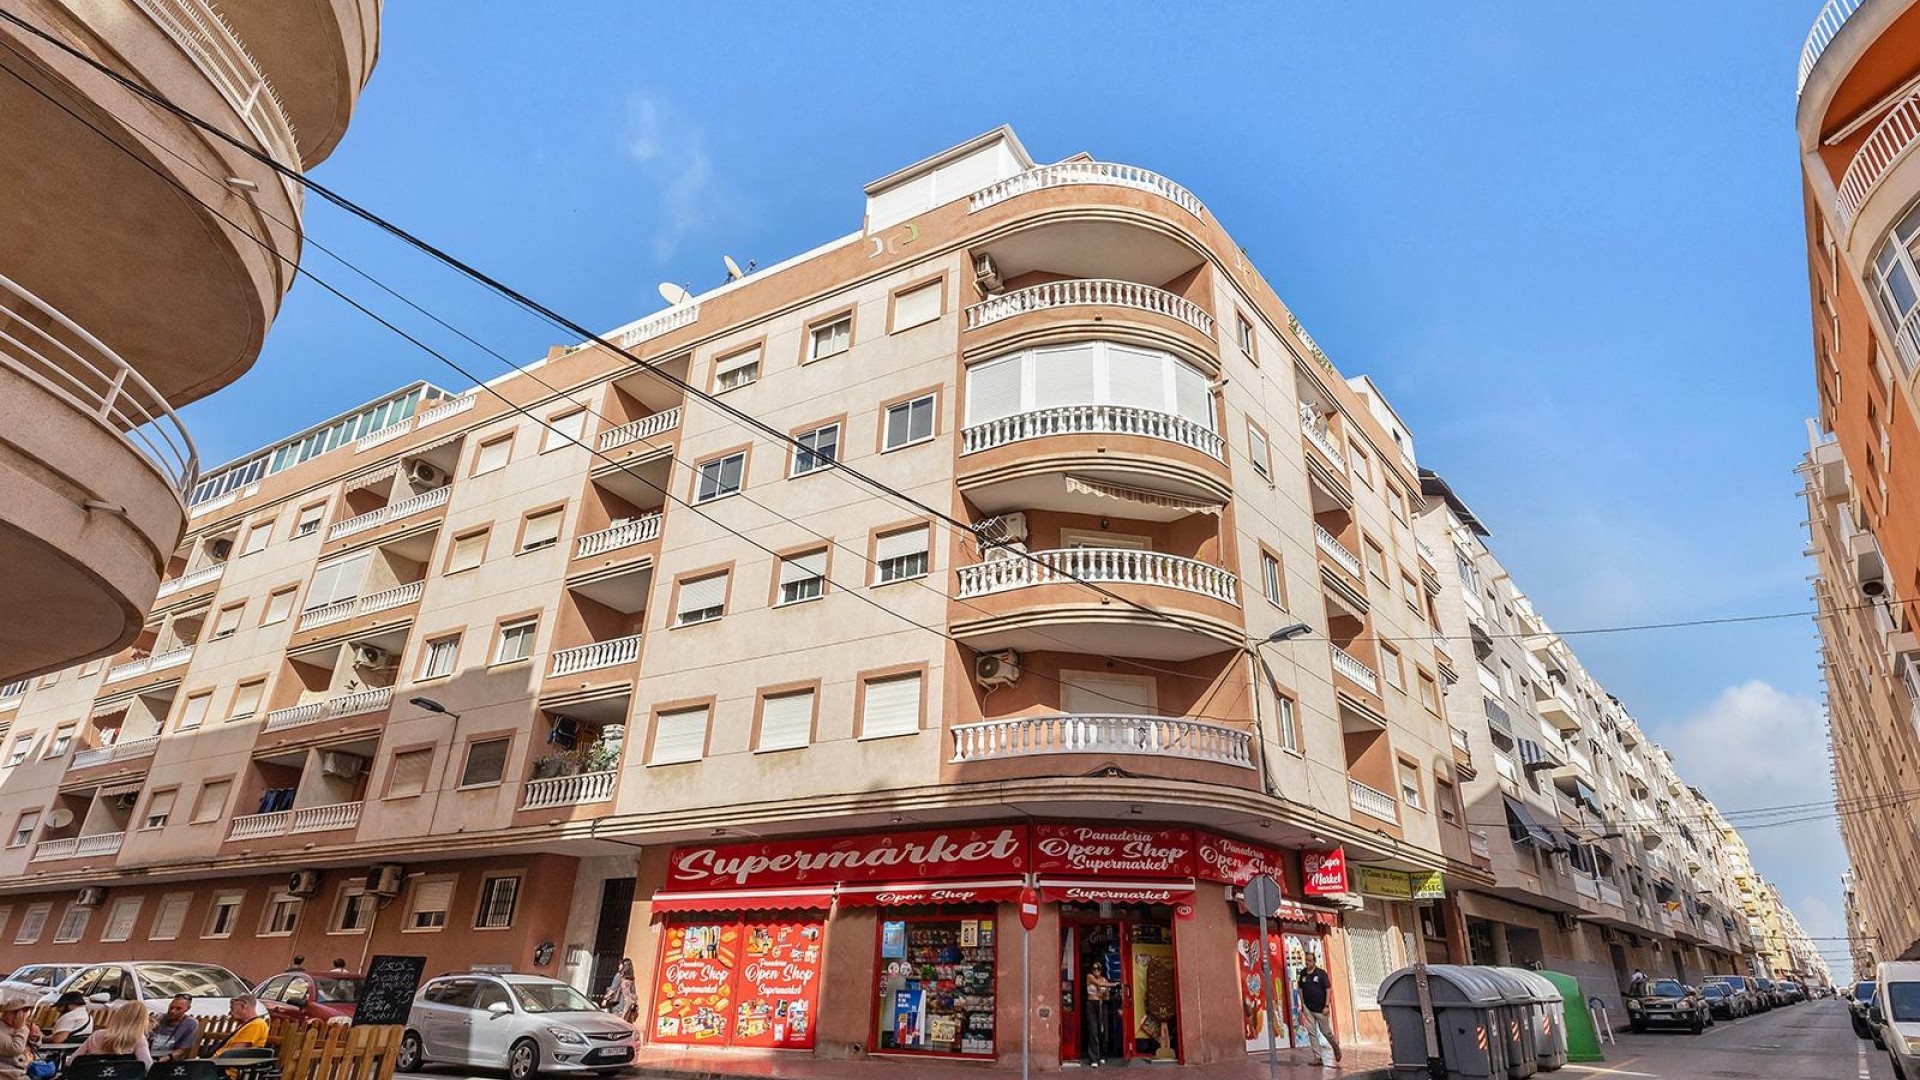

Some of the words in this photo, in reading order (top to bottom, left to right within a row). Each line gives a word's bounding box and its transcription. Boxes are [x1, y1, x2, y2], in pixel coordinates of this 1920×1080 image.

[674, 829, 1020, 885] Supermarket
[1038, 837, 1115, 861] Open
[1122, 841, 1188, 864] Shop
[1072, 855, 1169, 873] Supermarket
[1200, 845, 1244, 868] Open
[1249, 857, 1284, 881] Shop
[1319, 855, 1341, 870] Super
[1308, 872, 1342, 887] Market
[876, 891, 926, 904] Open
[930, 890, 977, 904] Shop
[1066, 888, 1171, 900] Supermarket
[666, 964, 697, 985] Open
[700, 964, 729, 985] Shop
[745, 963, 780, 985] Open
[782, 963, 815, 986] Shop
